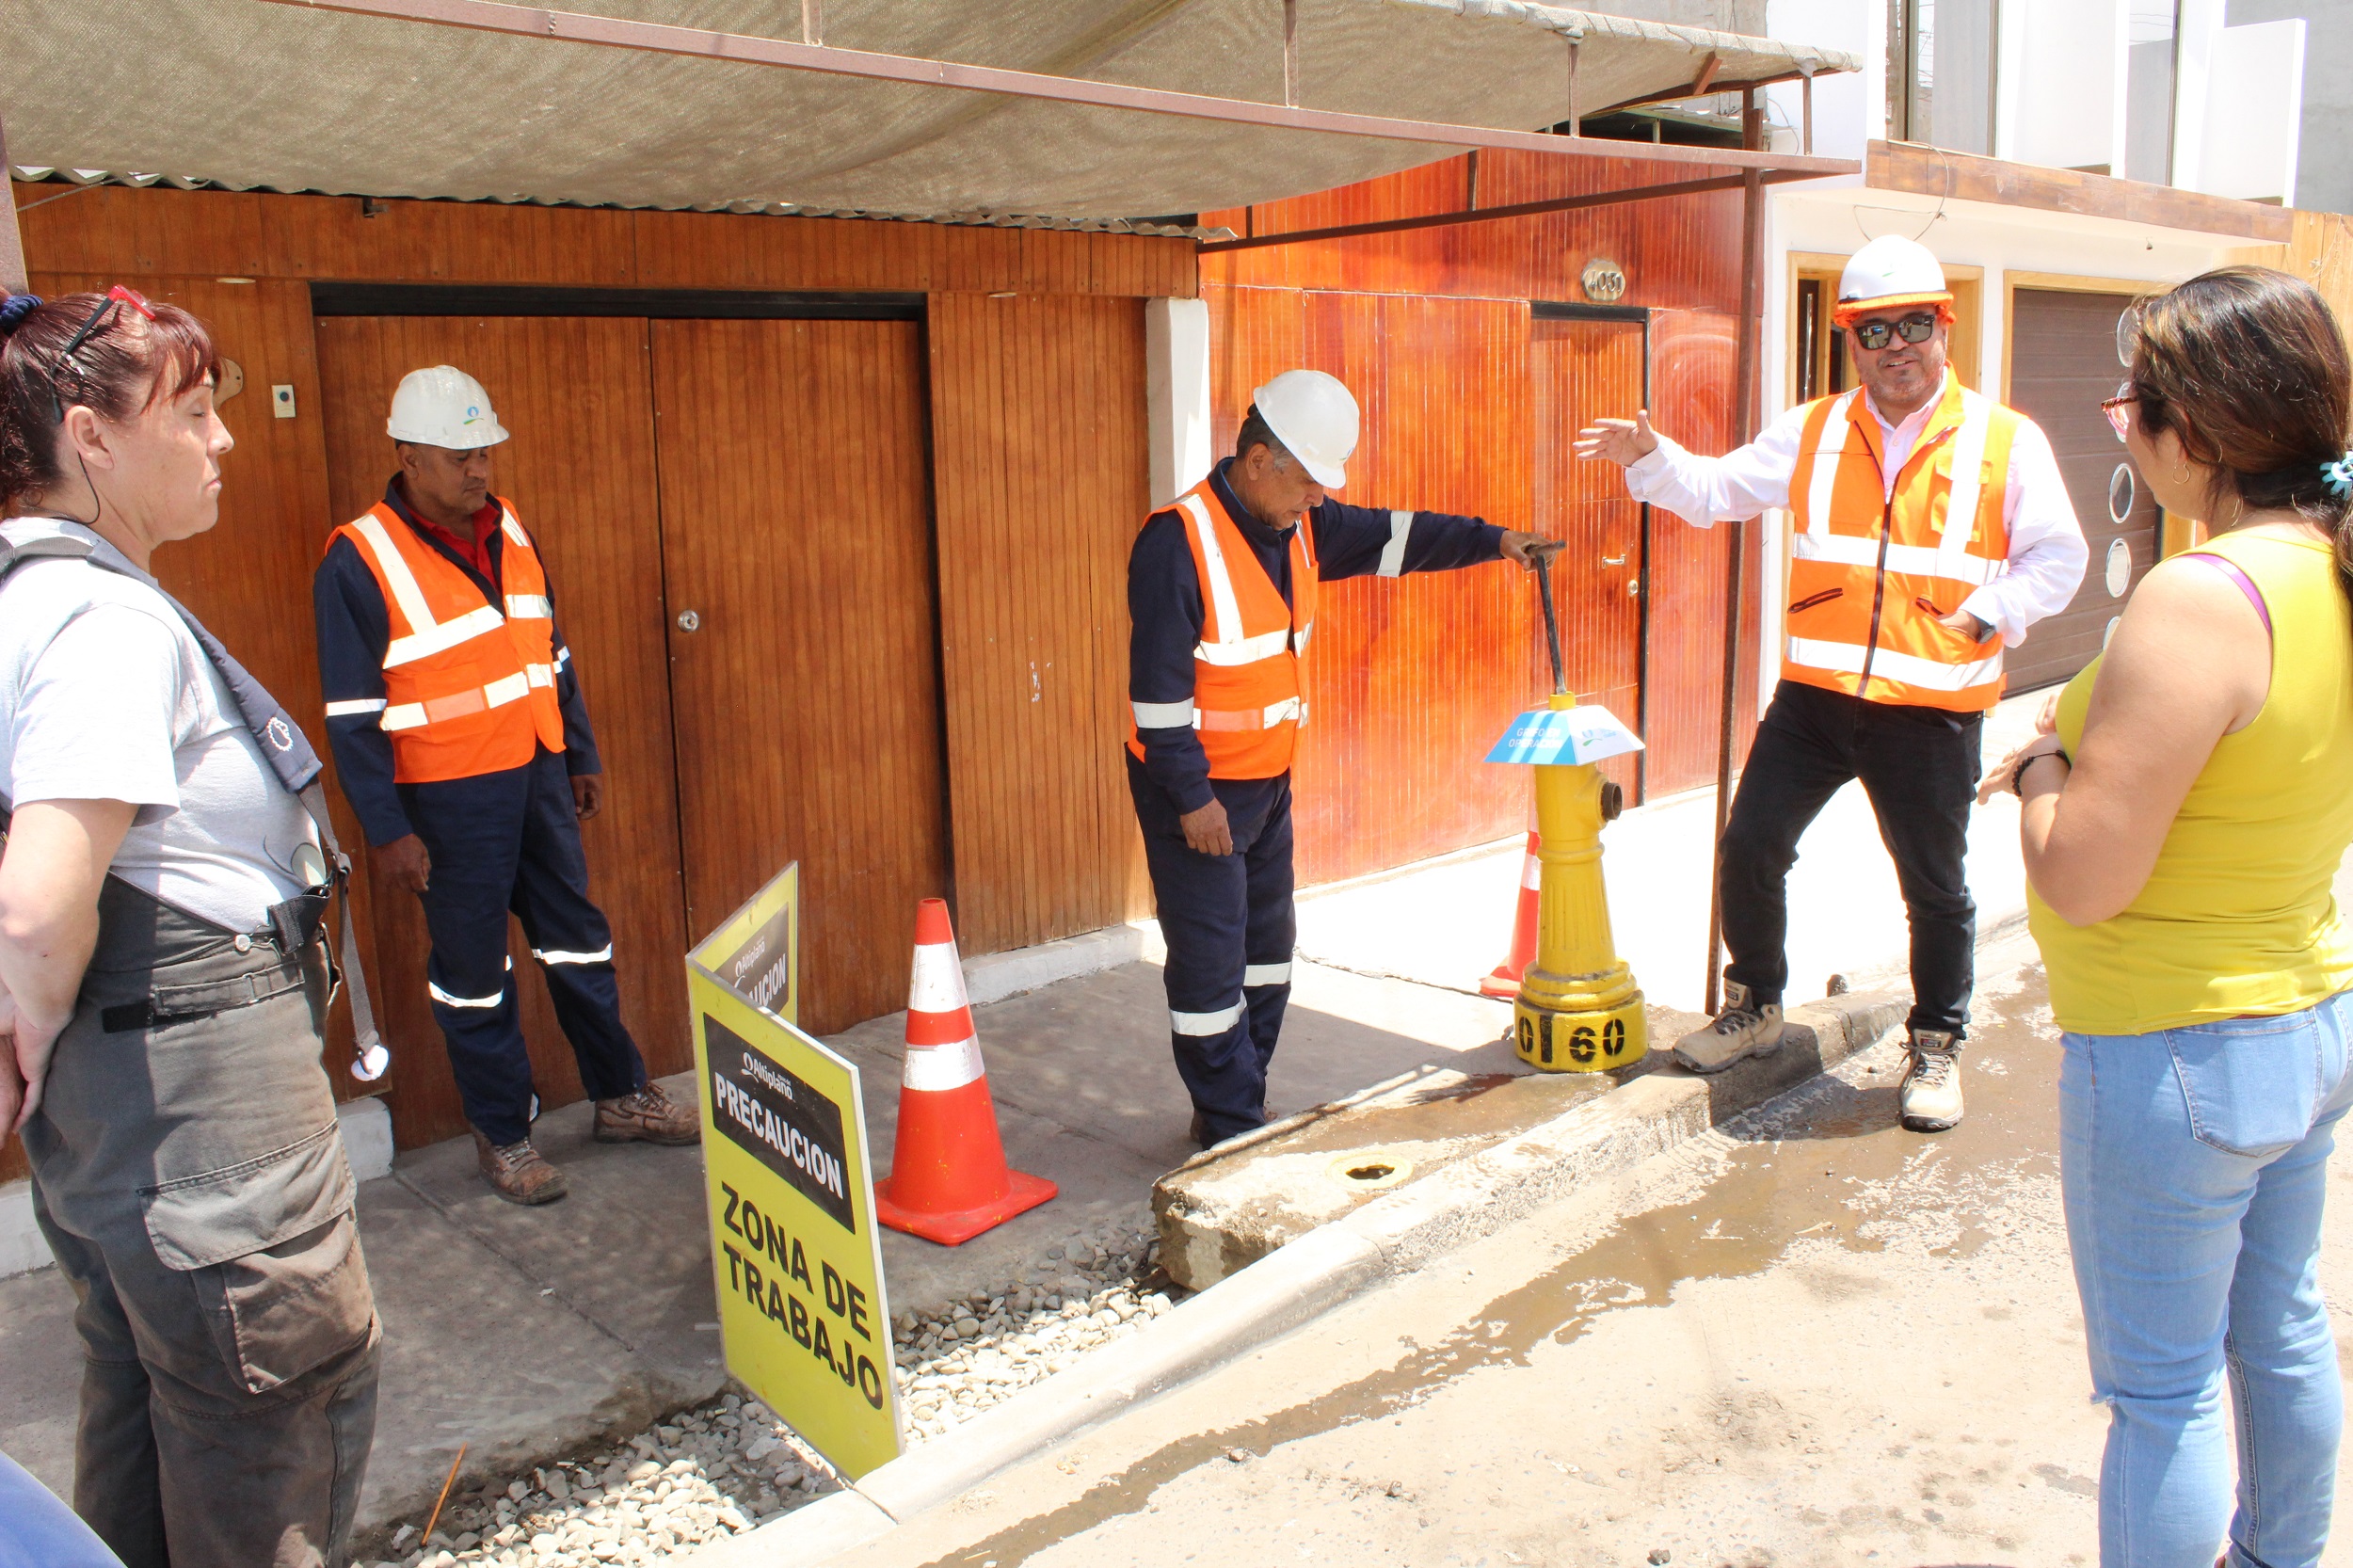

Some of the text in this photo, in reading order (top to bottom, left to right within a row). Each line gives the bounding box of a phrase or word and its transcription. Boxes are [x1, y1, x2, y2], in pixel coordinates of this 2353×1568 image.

[714, 1071, 843, 1200] PRECAUCION
[753, 1058, 793, 1100] Altiplano
[721, 1180, 872, 1343] ZONA DE
[722, 1240, 884, 1411] TRABAJO
